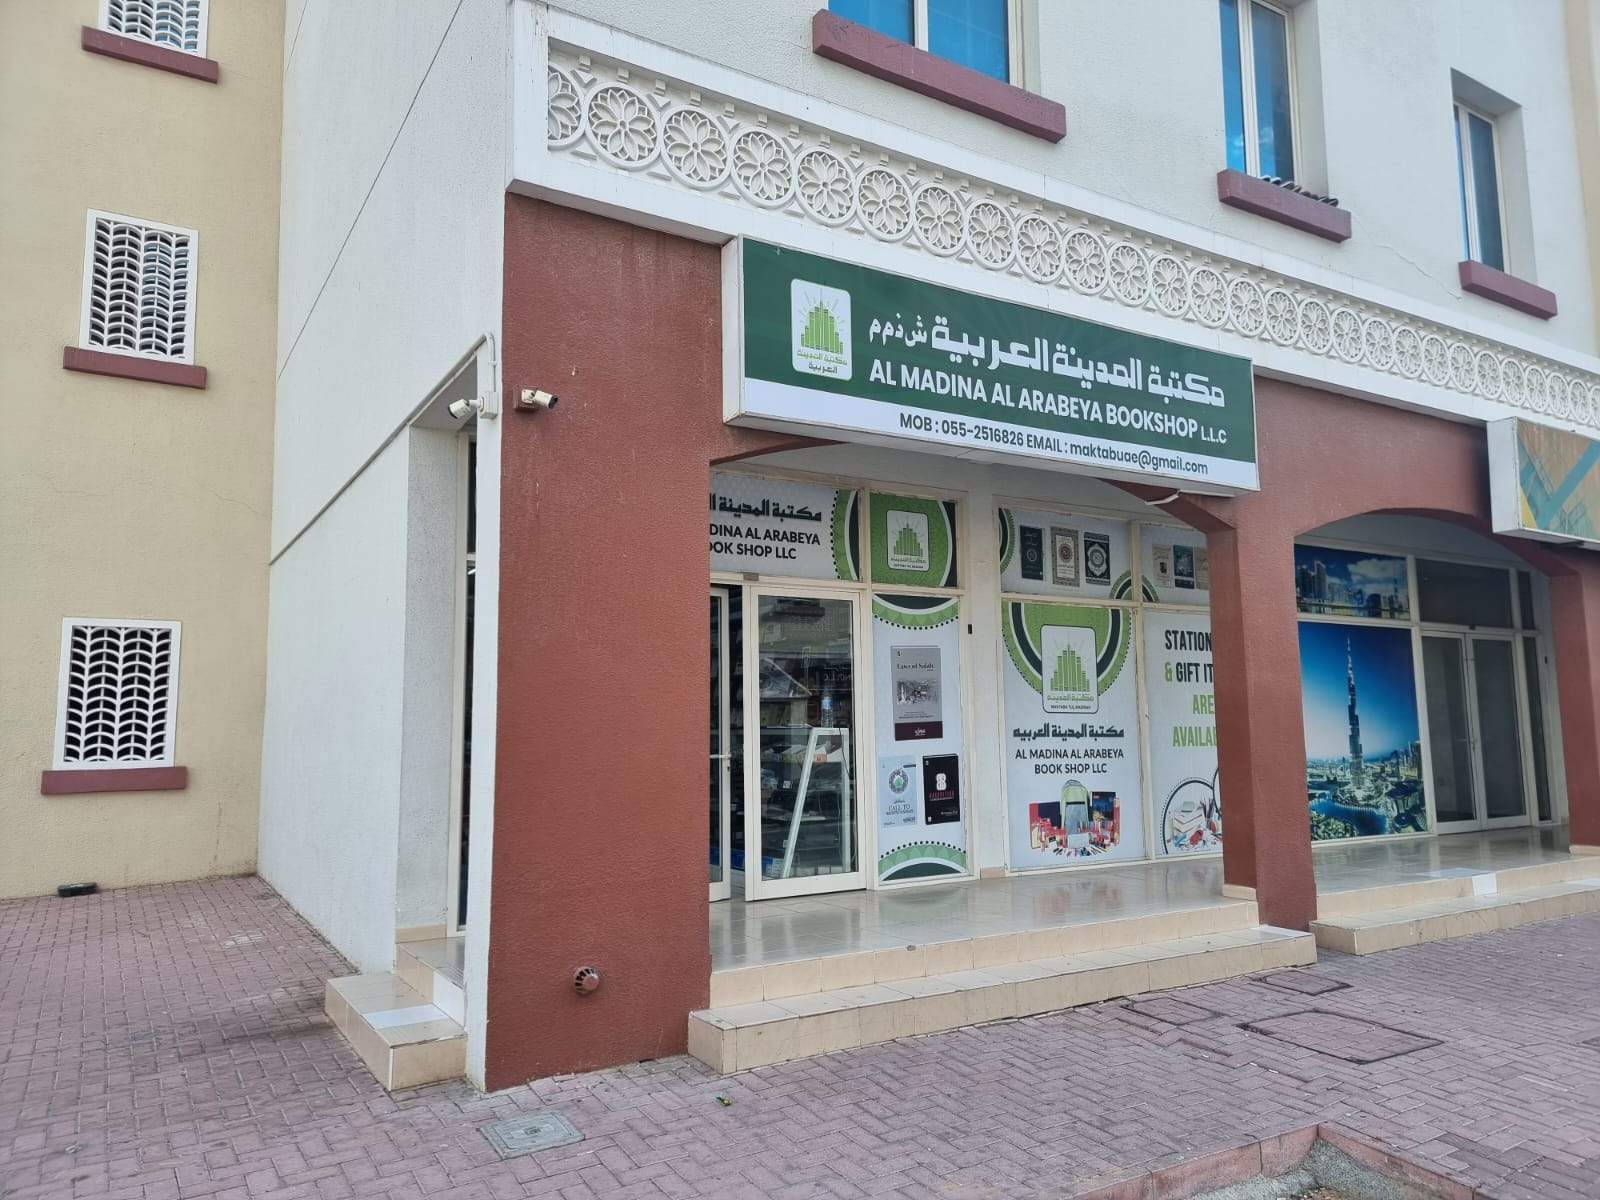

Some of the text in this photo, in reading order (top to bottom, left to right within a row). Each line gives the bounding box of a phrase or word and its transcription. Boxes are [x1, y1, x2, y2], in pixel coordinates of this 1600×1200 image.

[931, 315, 1049, 373] العربية
[1053, 343, 1143, 390] المدينة
[1148, 365, 1225, 407] مكتبة
[869, 359, 897, 386] AL
[901, 364, 987, 402] MADINA
[991, 382, 1016, 408] AL
[1018, 388, 1103, 423] ARABEYA
[1106, 403, 1198, 438] BOOKSHOP
[941, 419, 1024, 447] 055-2516826
[1070, 441, 1208, 474] maktabuae@gmail.com
[719, 496, 770, 518] المدينة
[772, 502, 822, 522] مكتبة
[710, 523, 821, 545] DINA AL ARABEYA
[736, 543, 772, 558] SHOP
[775, 546, 797, 559] LLC
[1165, 630, 1213, 652] STATION
[1164, 661, 1173, 682] &
[1175, 661, 1200, 683] GIFT
[1192, 694, 1215, 715] ARE
[1051, 723, 1088, 742] المدينة
[1088, 725, 1125, 742] مكتبة
[1015, 748, 1125, 760] AL MADINA AL ARABEYA
[1034, 763, 1107, 775] BOOK SHOP LLC
